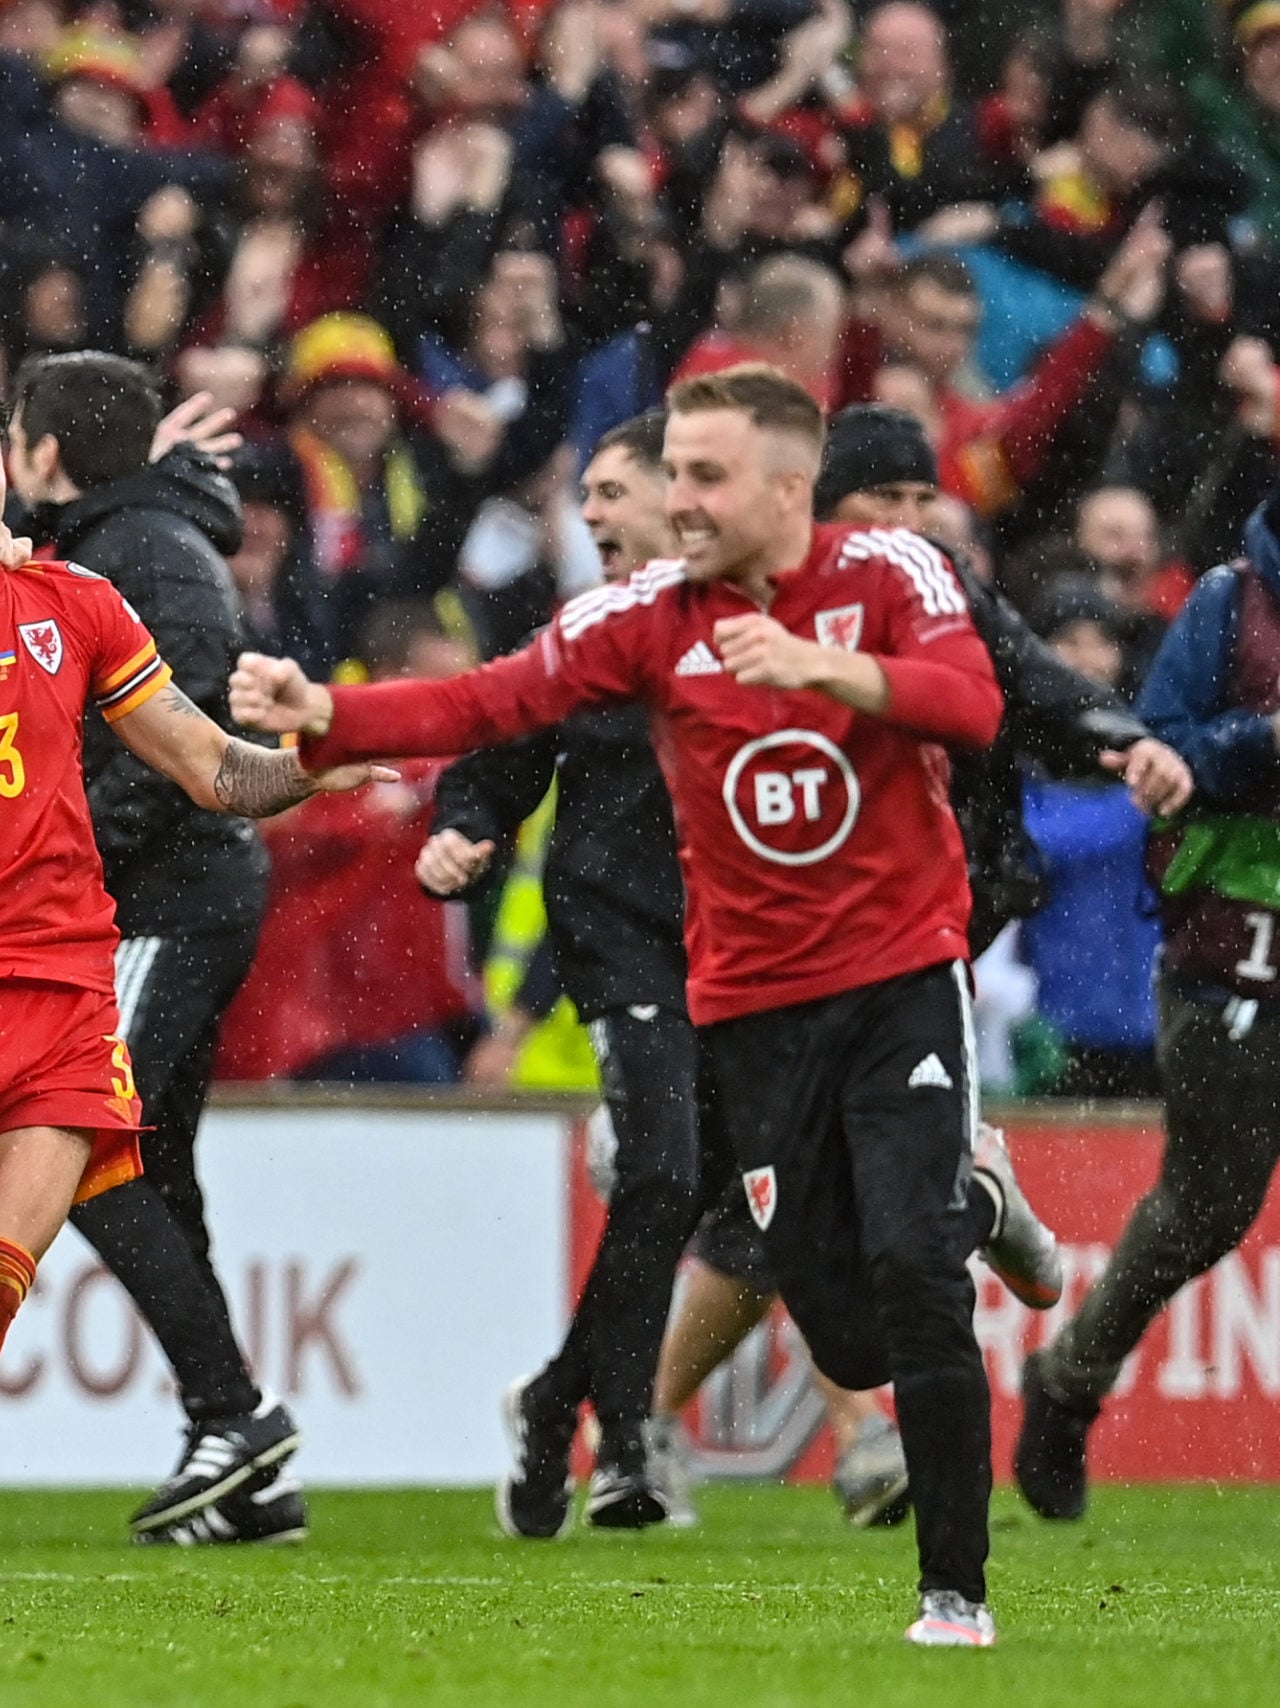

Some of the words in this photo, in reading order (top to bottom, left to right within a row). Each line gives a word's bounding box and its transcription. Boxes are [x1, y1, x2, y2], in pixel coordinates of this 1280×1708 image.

[753, 767, 828, 827] BT
[1235, 910, 1278, 983] 1
[101, 1034, 136, 1101] 3
